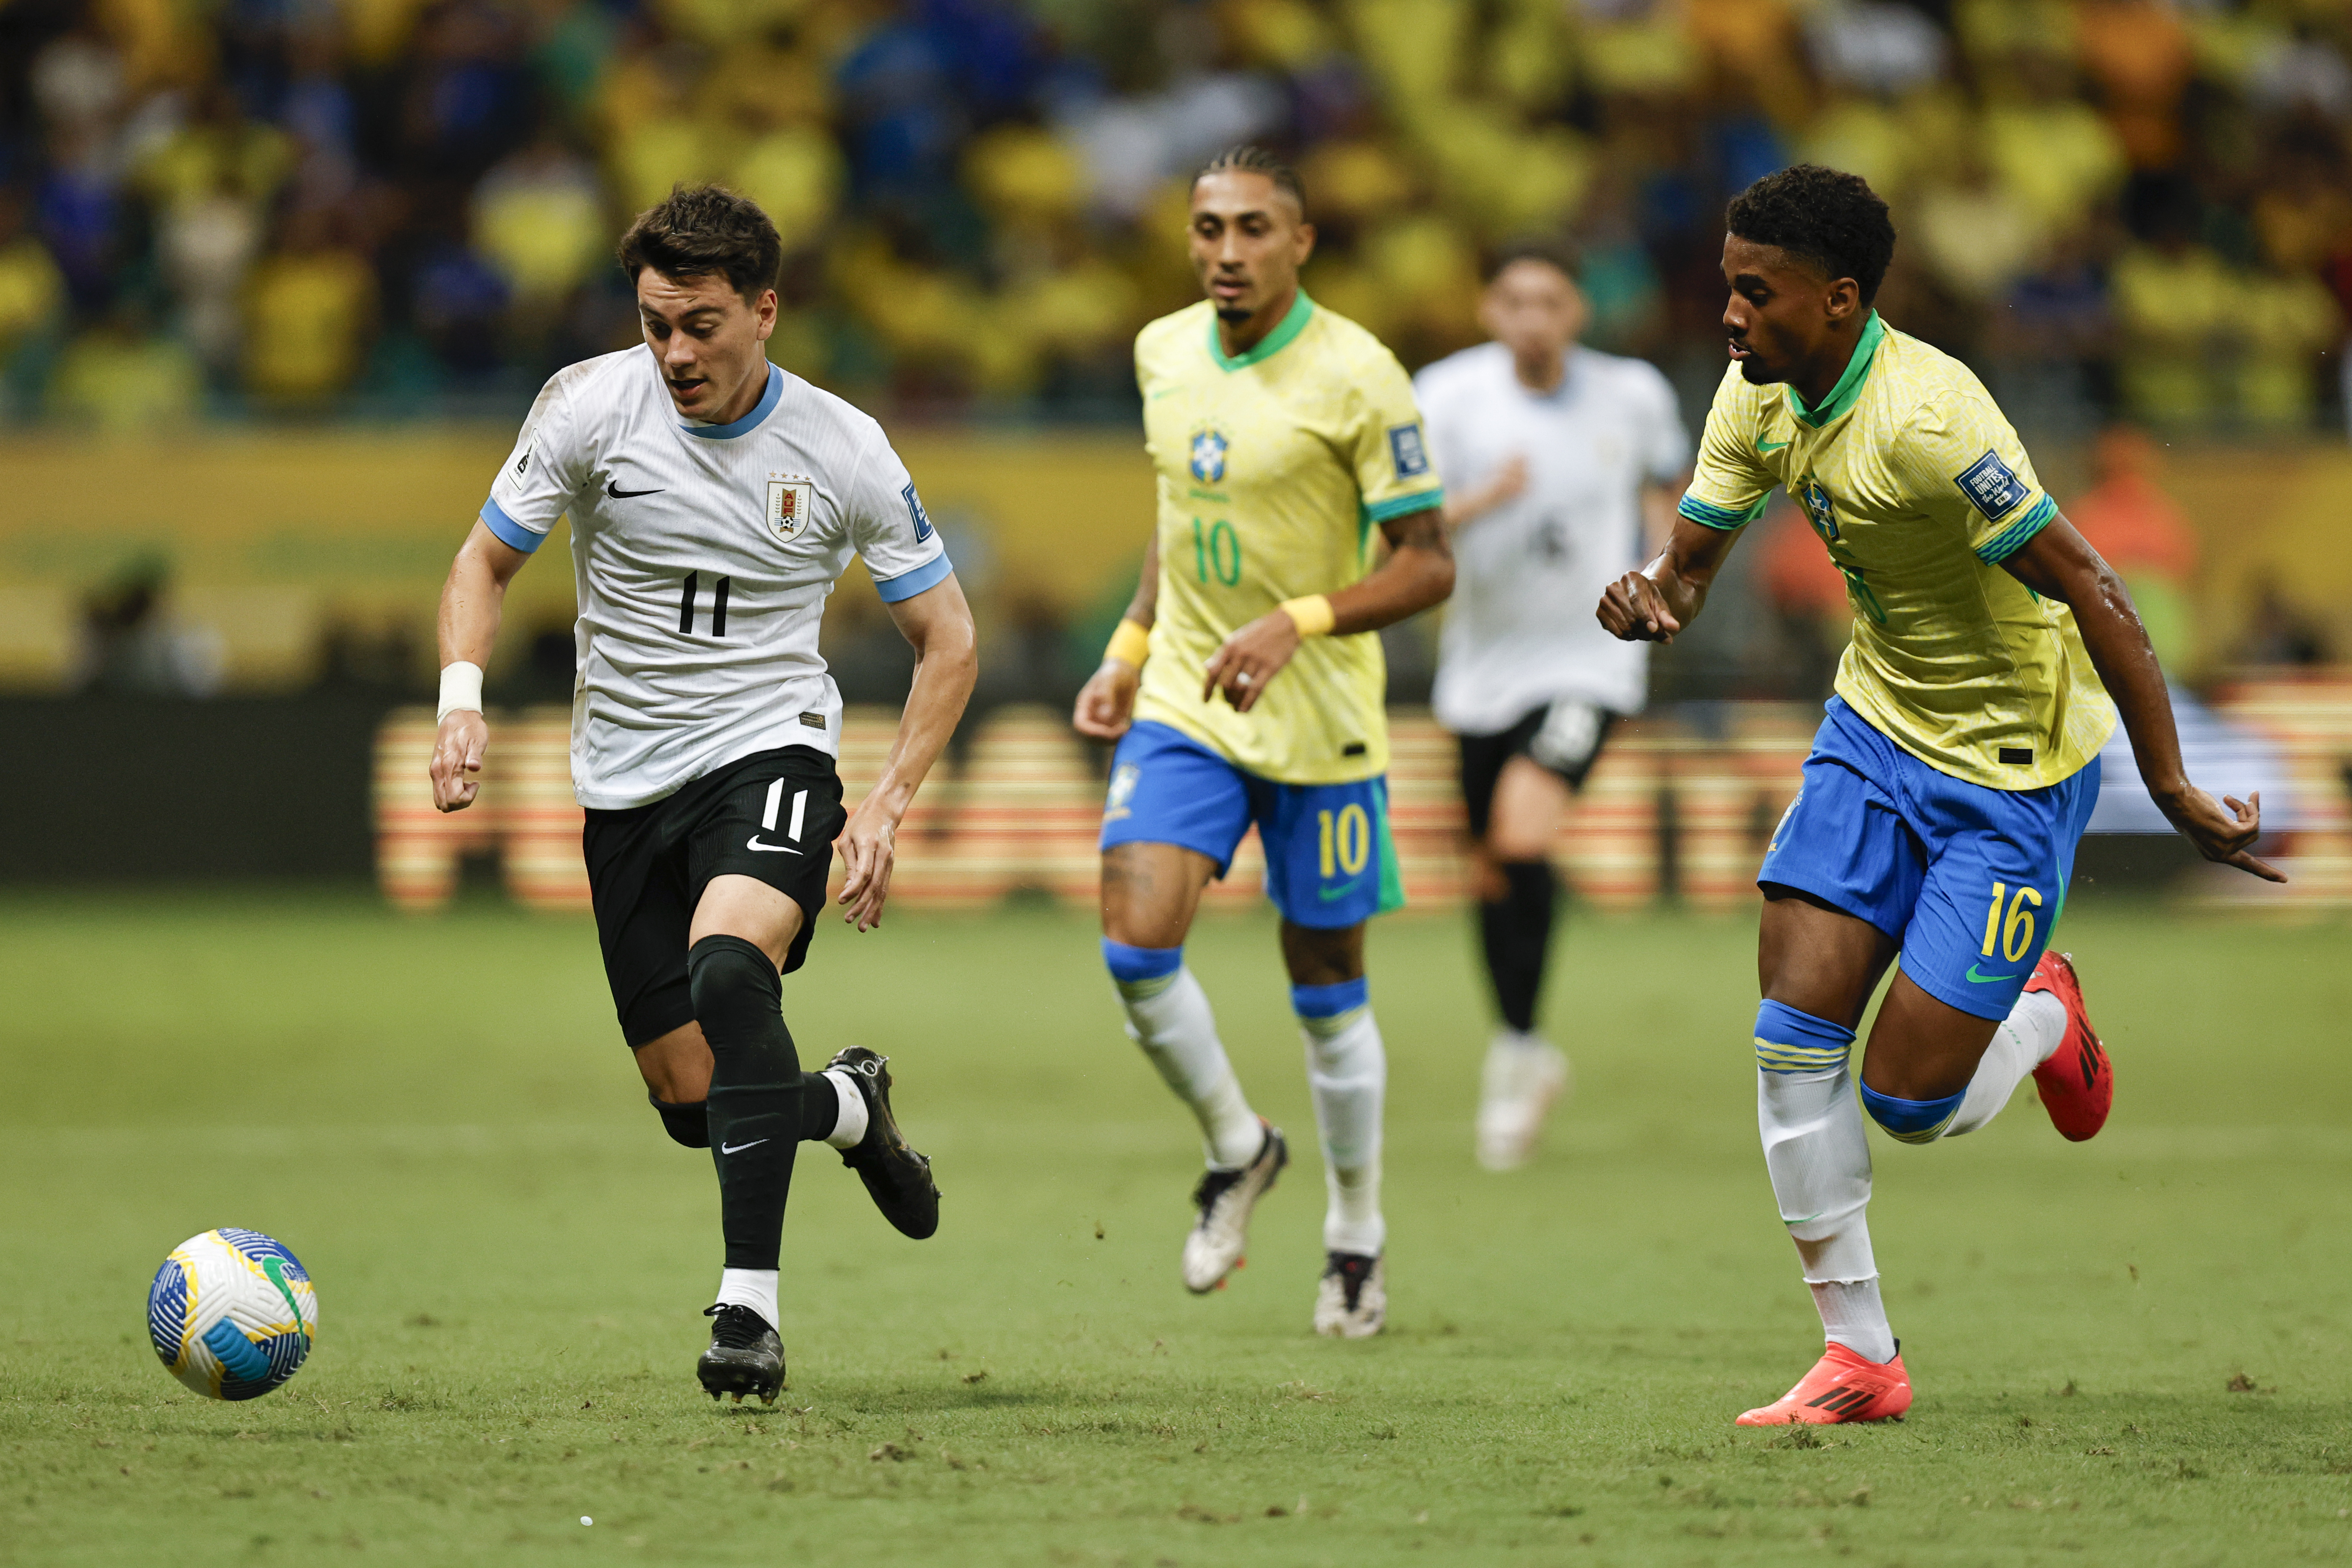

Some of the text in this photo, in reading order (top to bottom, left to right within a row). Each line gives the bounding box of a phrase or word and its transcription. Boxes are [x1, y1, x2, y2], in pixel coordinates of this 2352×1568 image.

[1969, 464, 1996, 487] FOOTBALL
[1974, 470, 2003, 495] UNITES
[1981, 476, 2010, 503] the World
[1997, 494, 2008, 504] FIFA
[784, 494, 793, 514] AUF
[1193, 516, 1241, 587] 10
[679, 570, 730, 636] 11
[762, 777, 808, 843] 11
[1318, 803, 1370, 879] 10
[1981, 882, 2043, 962] 16
[1844, 1379, 1888, 1394] F50
